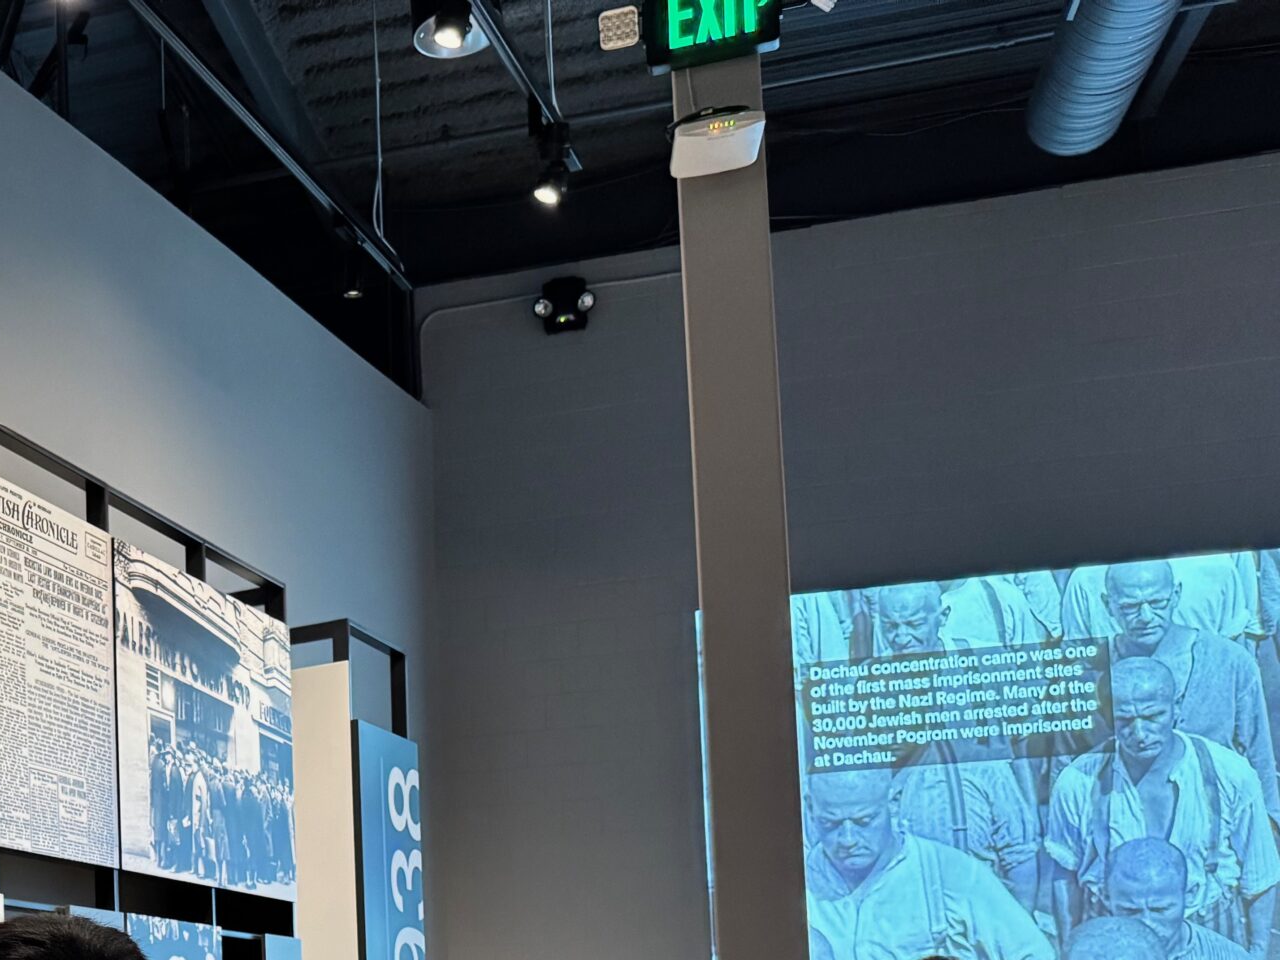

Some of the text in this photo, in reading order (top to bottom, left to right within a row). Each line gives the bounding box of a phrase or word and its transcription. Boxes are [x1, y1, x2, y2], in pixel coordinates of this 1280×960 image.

[810, 662, 1084, 698] of the first mass imprisonment sites
[811, 645, 1098, 681] Dachau concentration camp was one
[812, 680, 1098, 715] built by the Nazi Regime. Many of the
[813, 698, 1098, 733] 30,000 Jewish men arrested after the
[814, 715, 1093, 751] November Pogrom were imprisoned
[814, 750, 896, 767] at Dachau.
